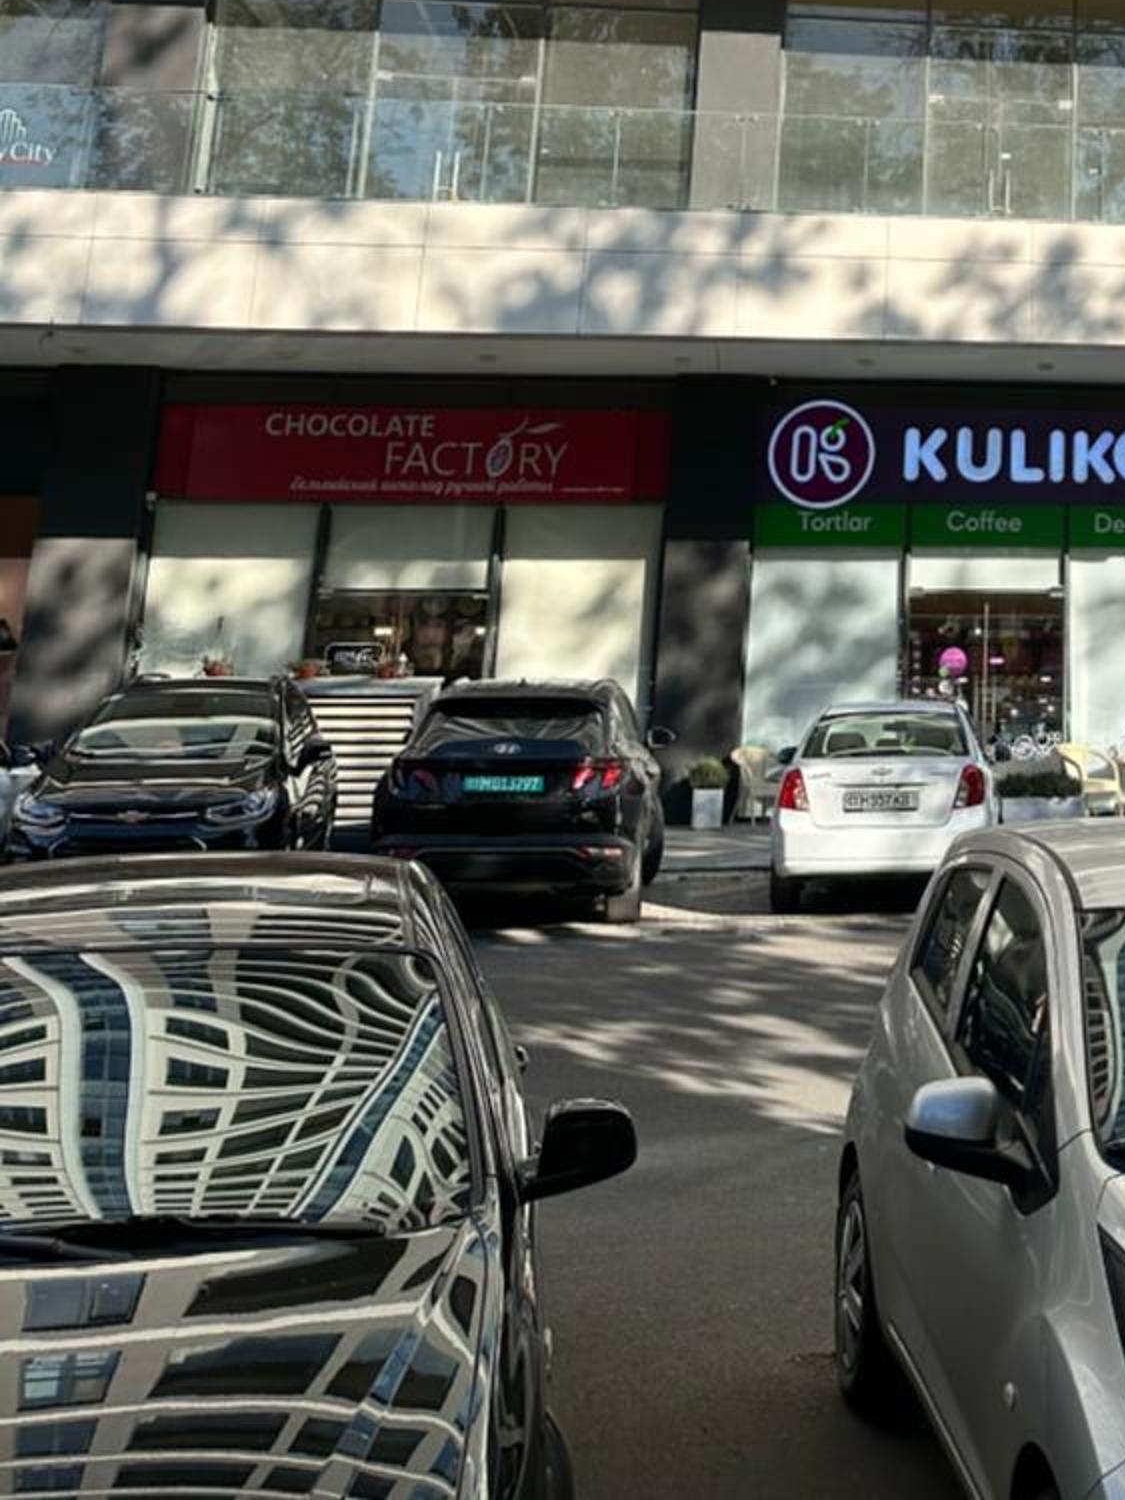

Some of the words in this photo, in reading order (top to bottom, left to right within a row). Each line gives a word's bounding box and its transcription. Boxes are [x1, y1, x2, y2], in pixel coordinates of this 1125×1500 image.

[264, 413, 436, 438] CHOCOLATE
[384, 436, 568, 478] FACTORY
[799, 510, 872, 533] Tortlar
[946, 510, 1023, 534] Coffee
